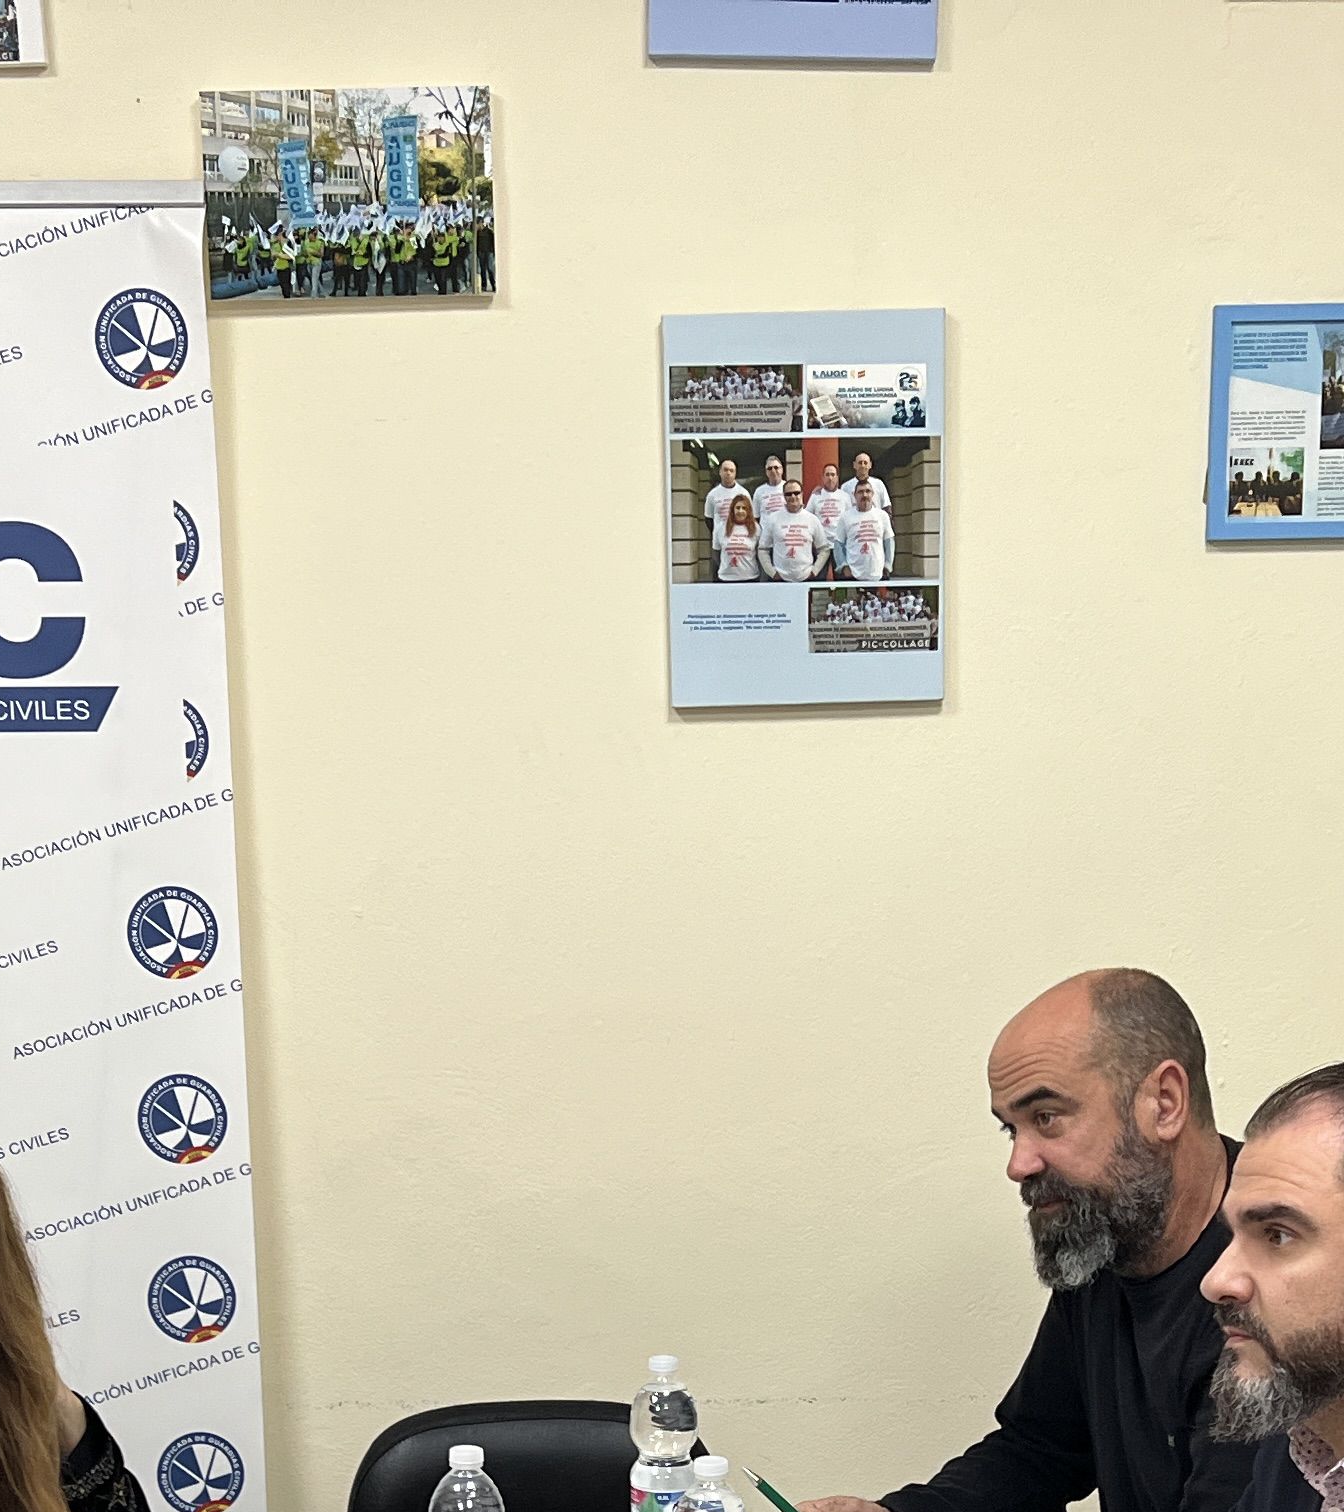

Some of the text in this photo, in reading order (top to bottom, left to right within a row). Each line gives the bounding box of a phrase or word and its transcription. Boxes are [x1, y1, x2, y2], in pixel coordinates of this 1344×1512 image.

[81, 403, 174, 442] UNIFICADA
[173, 394, 199, 414] DE
[1, 792, 219, 871] ASOCIACIÓN UNIFICADA DE
[13, 983, 228, 1061] ASOCIACIÓN UNIFICADA DE
[8, 1127, 70, 1156] CIVILES
[24, 1167, 237, 1243] ASOCIACIÓN UNIFICADA DE
[134, 1354, 222, 1391] UNIFICADA
[221, 1345, 246, 1363] DE
